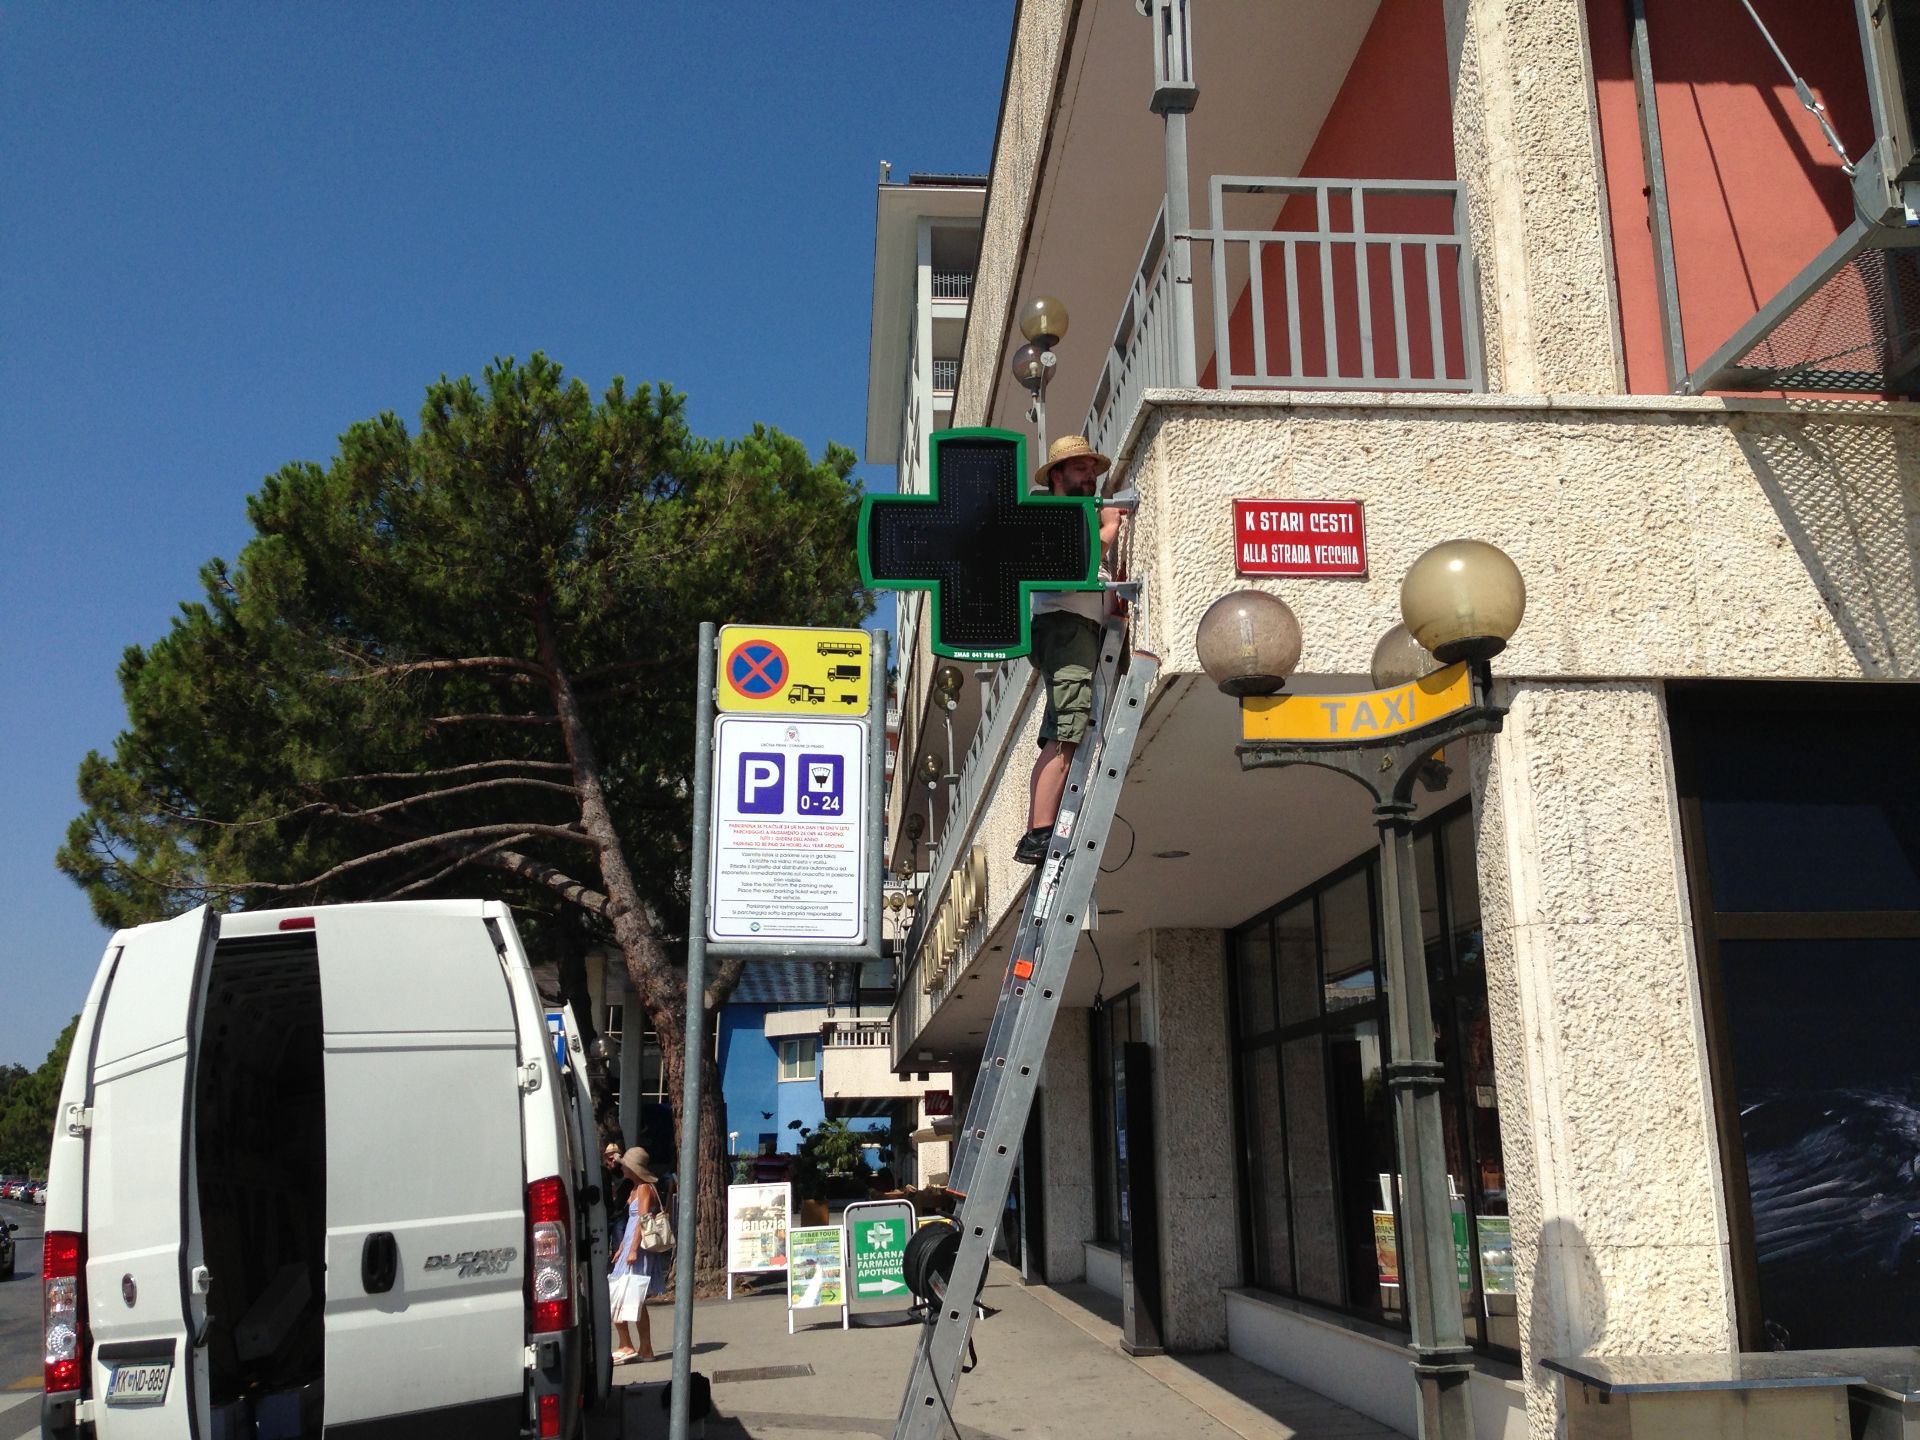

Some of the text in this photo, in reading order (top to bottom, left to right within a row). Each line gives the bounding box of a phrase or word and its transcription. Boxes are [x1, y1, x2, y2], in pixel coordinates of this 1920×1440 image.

[1245, 512, 1352, 533] K STARI CESTI
[1244, 544, 1359, 564] ALLA STRADA VECCHIA
[1320, 690, 1416, 733] TAXI
[744, 760, 780, 803] P
[737, 1218, 785, 1232] enezia
[424, 1247, 517, 1272] DUCATO
[857, 1250, 904, 1260] LEKARNA
[115, 1368, 165, 1392] KK ND-889
